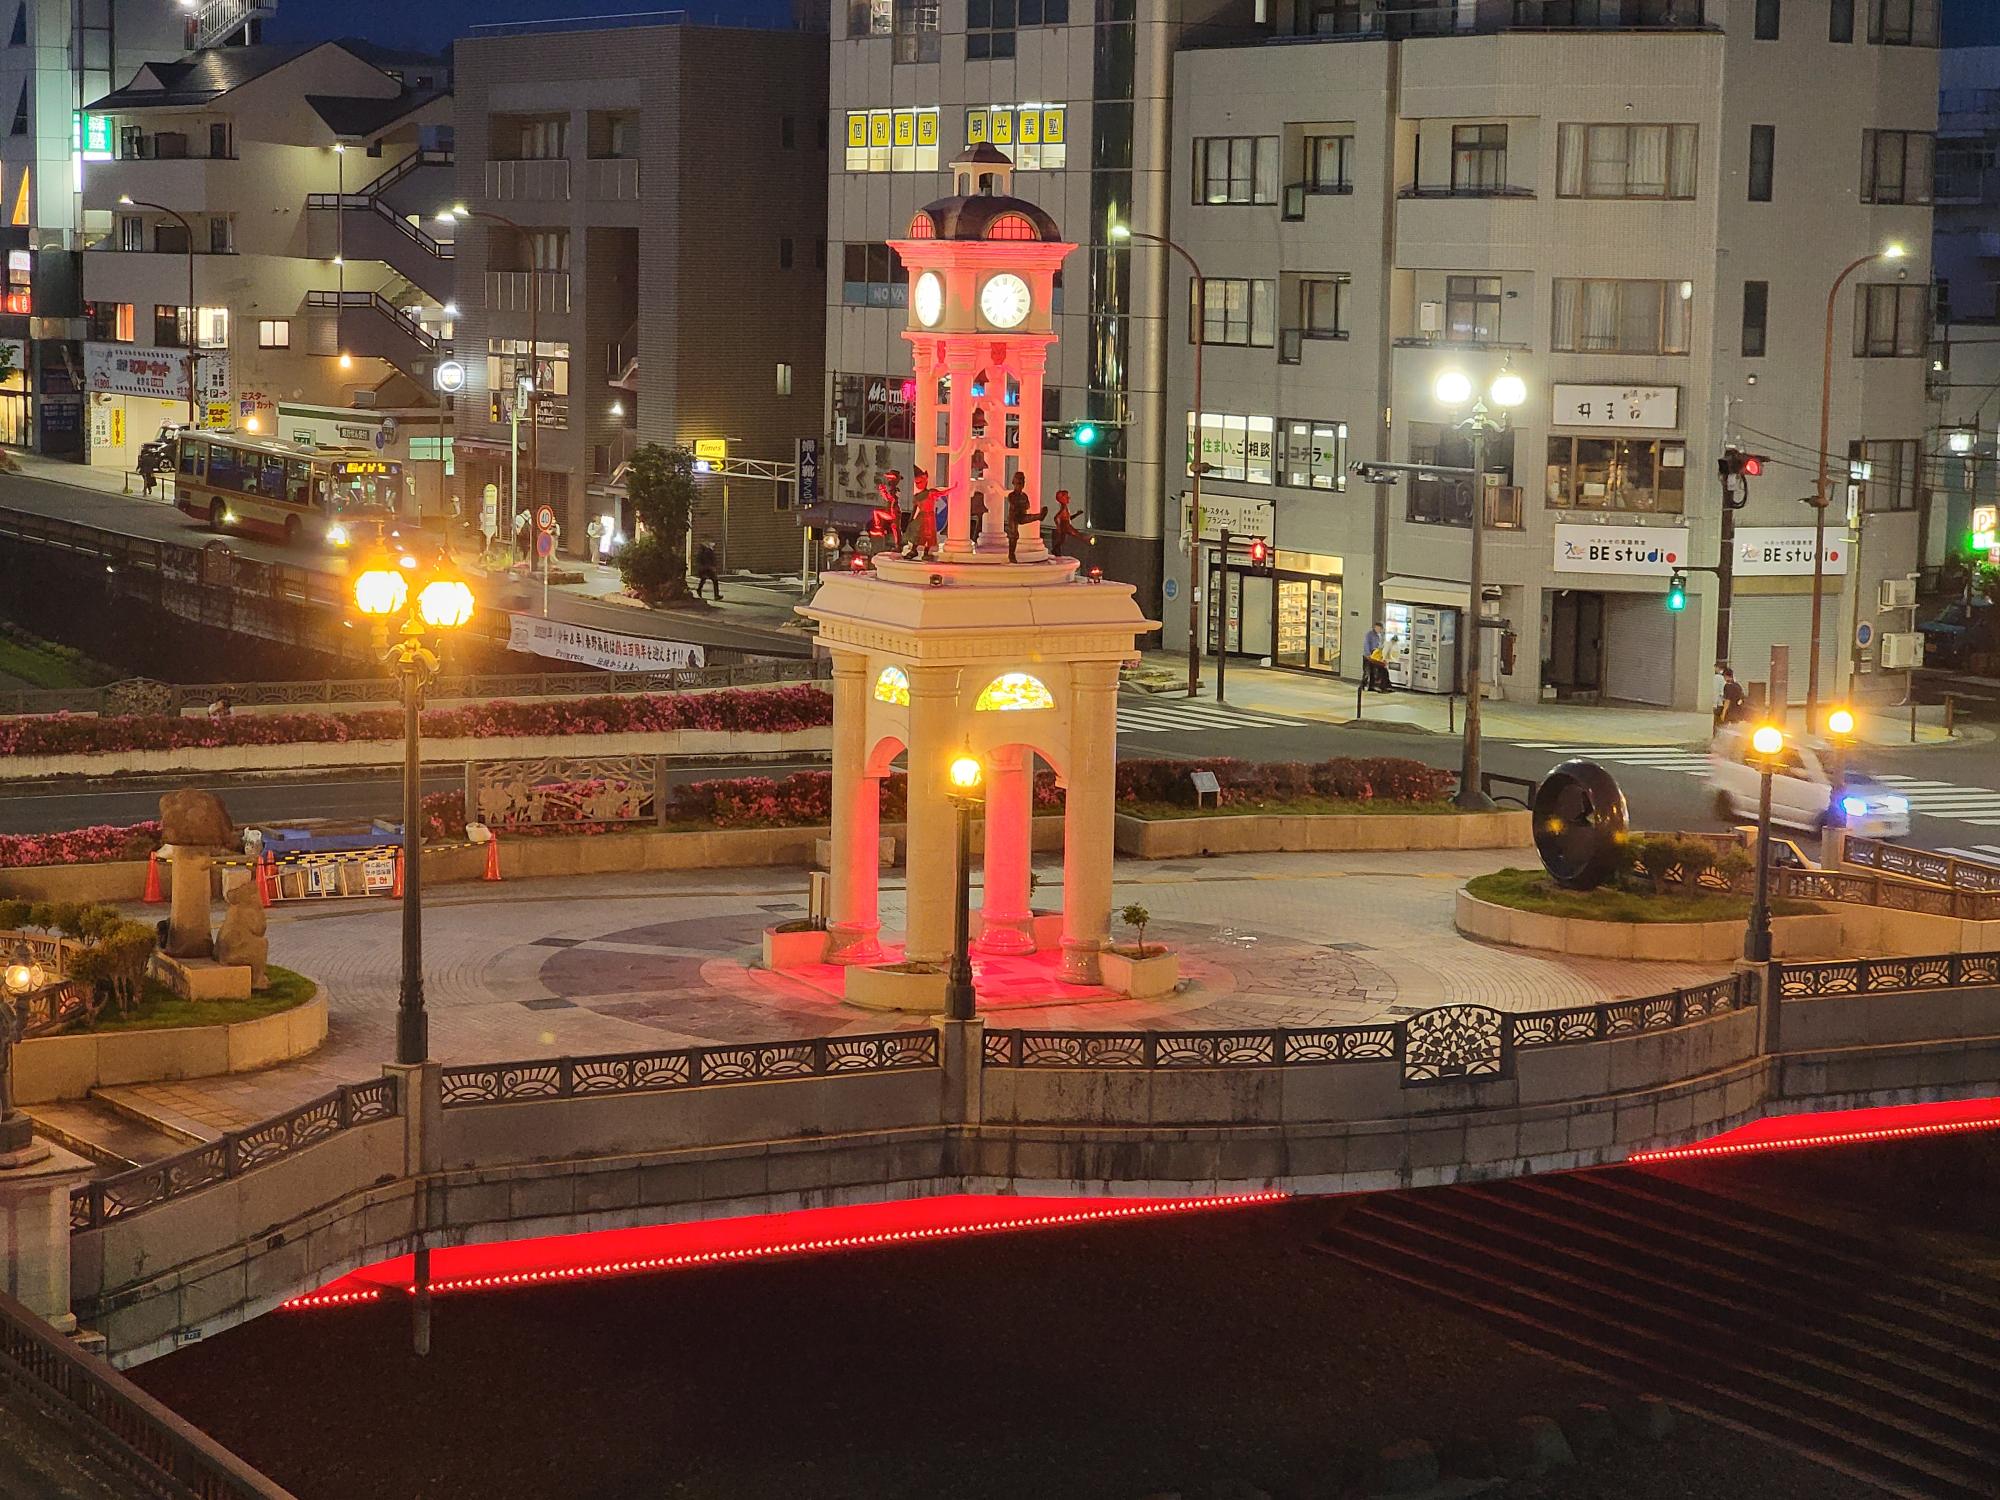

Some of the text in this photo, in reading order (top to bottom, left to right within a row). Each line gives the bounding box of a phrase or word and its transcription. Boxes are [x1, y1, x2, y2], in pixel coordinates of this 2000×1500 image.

[853, 120, 933, 139] 個別指導
[972, 118, 1058, 136] 明光義塾
[873, 287, 905, 300] NOVA
[241, 391, 267, 400] ミスター
[257, 400, 274, 409] カット
[1290, 446, 1322, 462] コチラ
[802, 439, 815, 499] 婦人靴さくら
[541, 512, 550, 523] 40
[1207, 516, 1237, 525] プランニング
[1589, 545, 1677, 563] BE studio
[1763, 547, 1839, 562] BE stuio
